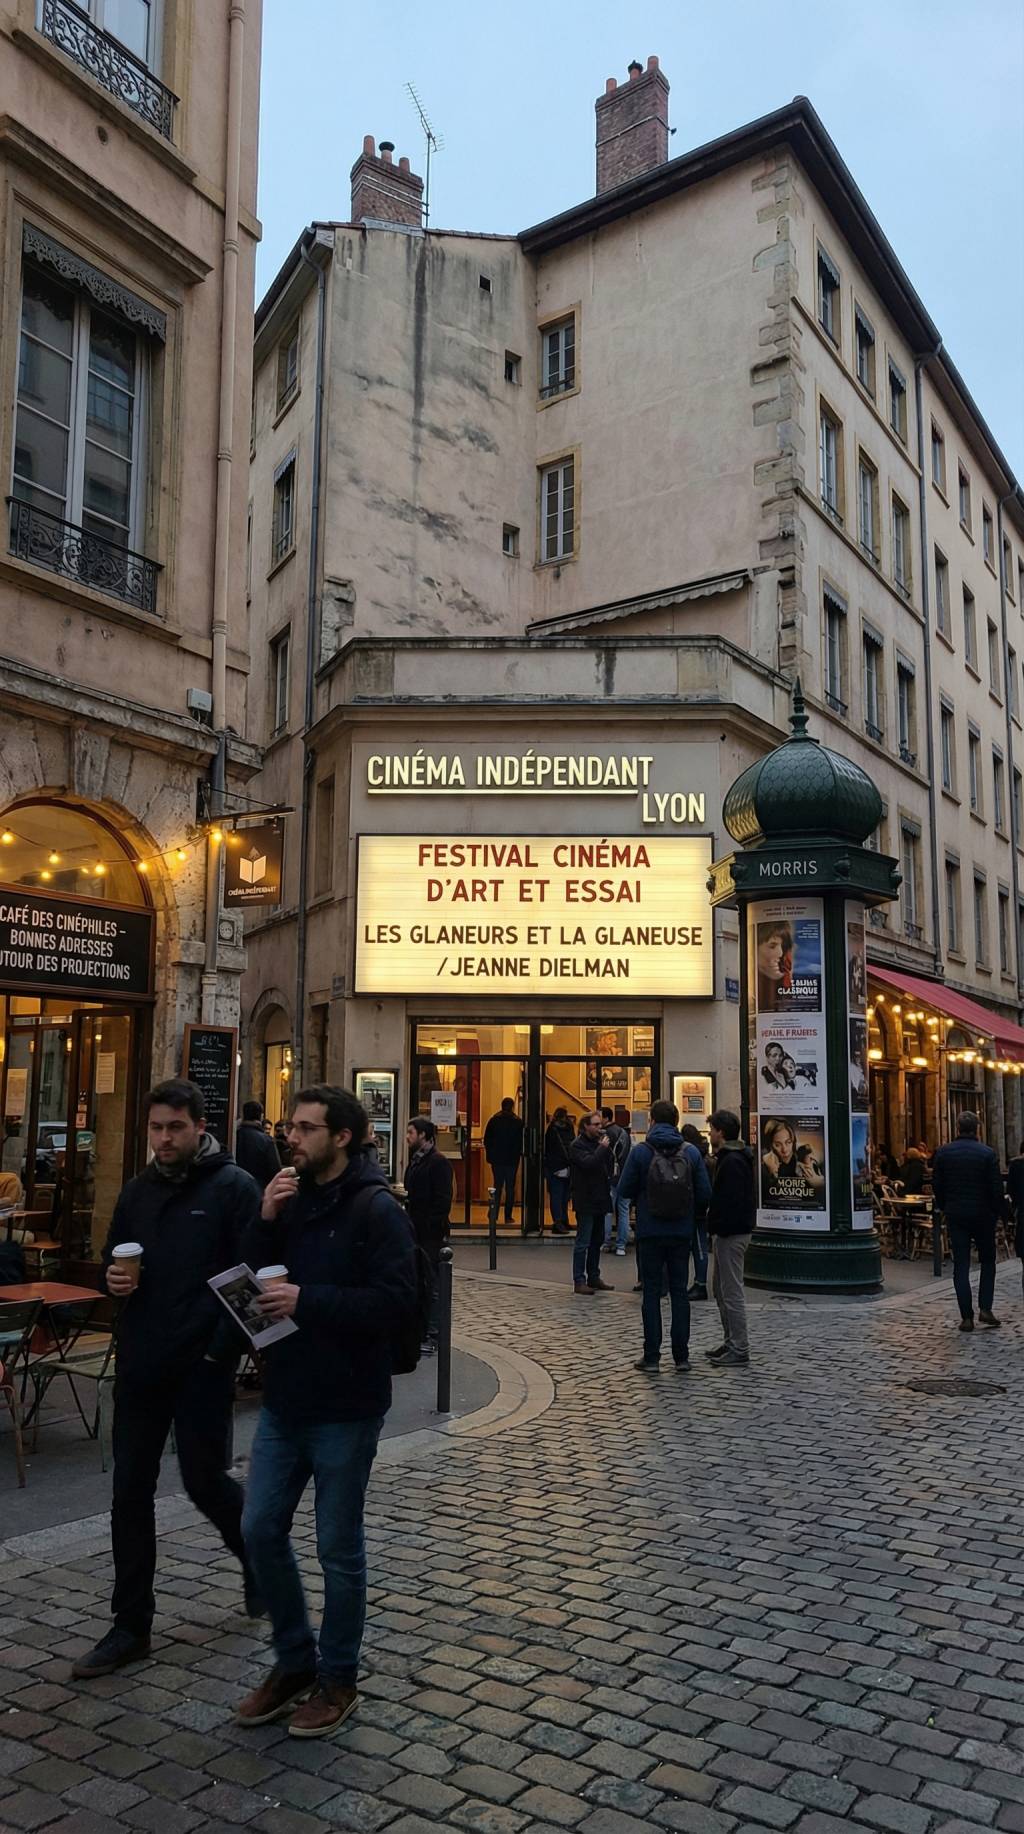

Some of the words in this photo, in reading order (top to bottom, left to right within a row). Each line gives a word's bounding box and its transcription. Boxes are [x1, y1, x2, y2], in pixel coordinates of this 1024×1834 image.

[367, 749, 466, 786] CINÉMA
[477, 749, 654, 786] INDÉPENDANT
[642, 793, 705, 823] LYON
[418, 844, 539, 868] FESTIVAL
[553, 839, 651, 868] CINÉMA
[759, 860, 818, 877] MORRIS
[427, 879, 505, 903] D'ART
[519, 879, 551, 903] ET
[565, 879, 642, 903] ESSAI
[0, 905, 29, 925] CAFÉ
[31, 910, 54, 928] DES
[57, 913, 117, 937] CINÉPHILES
[10, 928, 56, 950] BONNES
[58, 936, 114, 958] ADRESSES
[364, 924, 401, 944] LES
[410, 925, 519, 945] GLANEURS
[527, 926, 552, 945] ET
[560, 926, 587, 946] LA
[595, 926, 703, 946] GLANEUSE
[36, 954, 59, 972] DES
[61, 957, 131, 980] PROJECTIONS
[539, 957, 630, 978] DIELMAN
